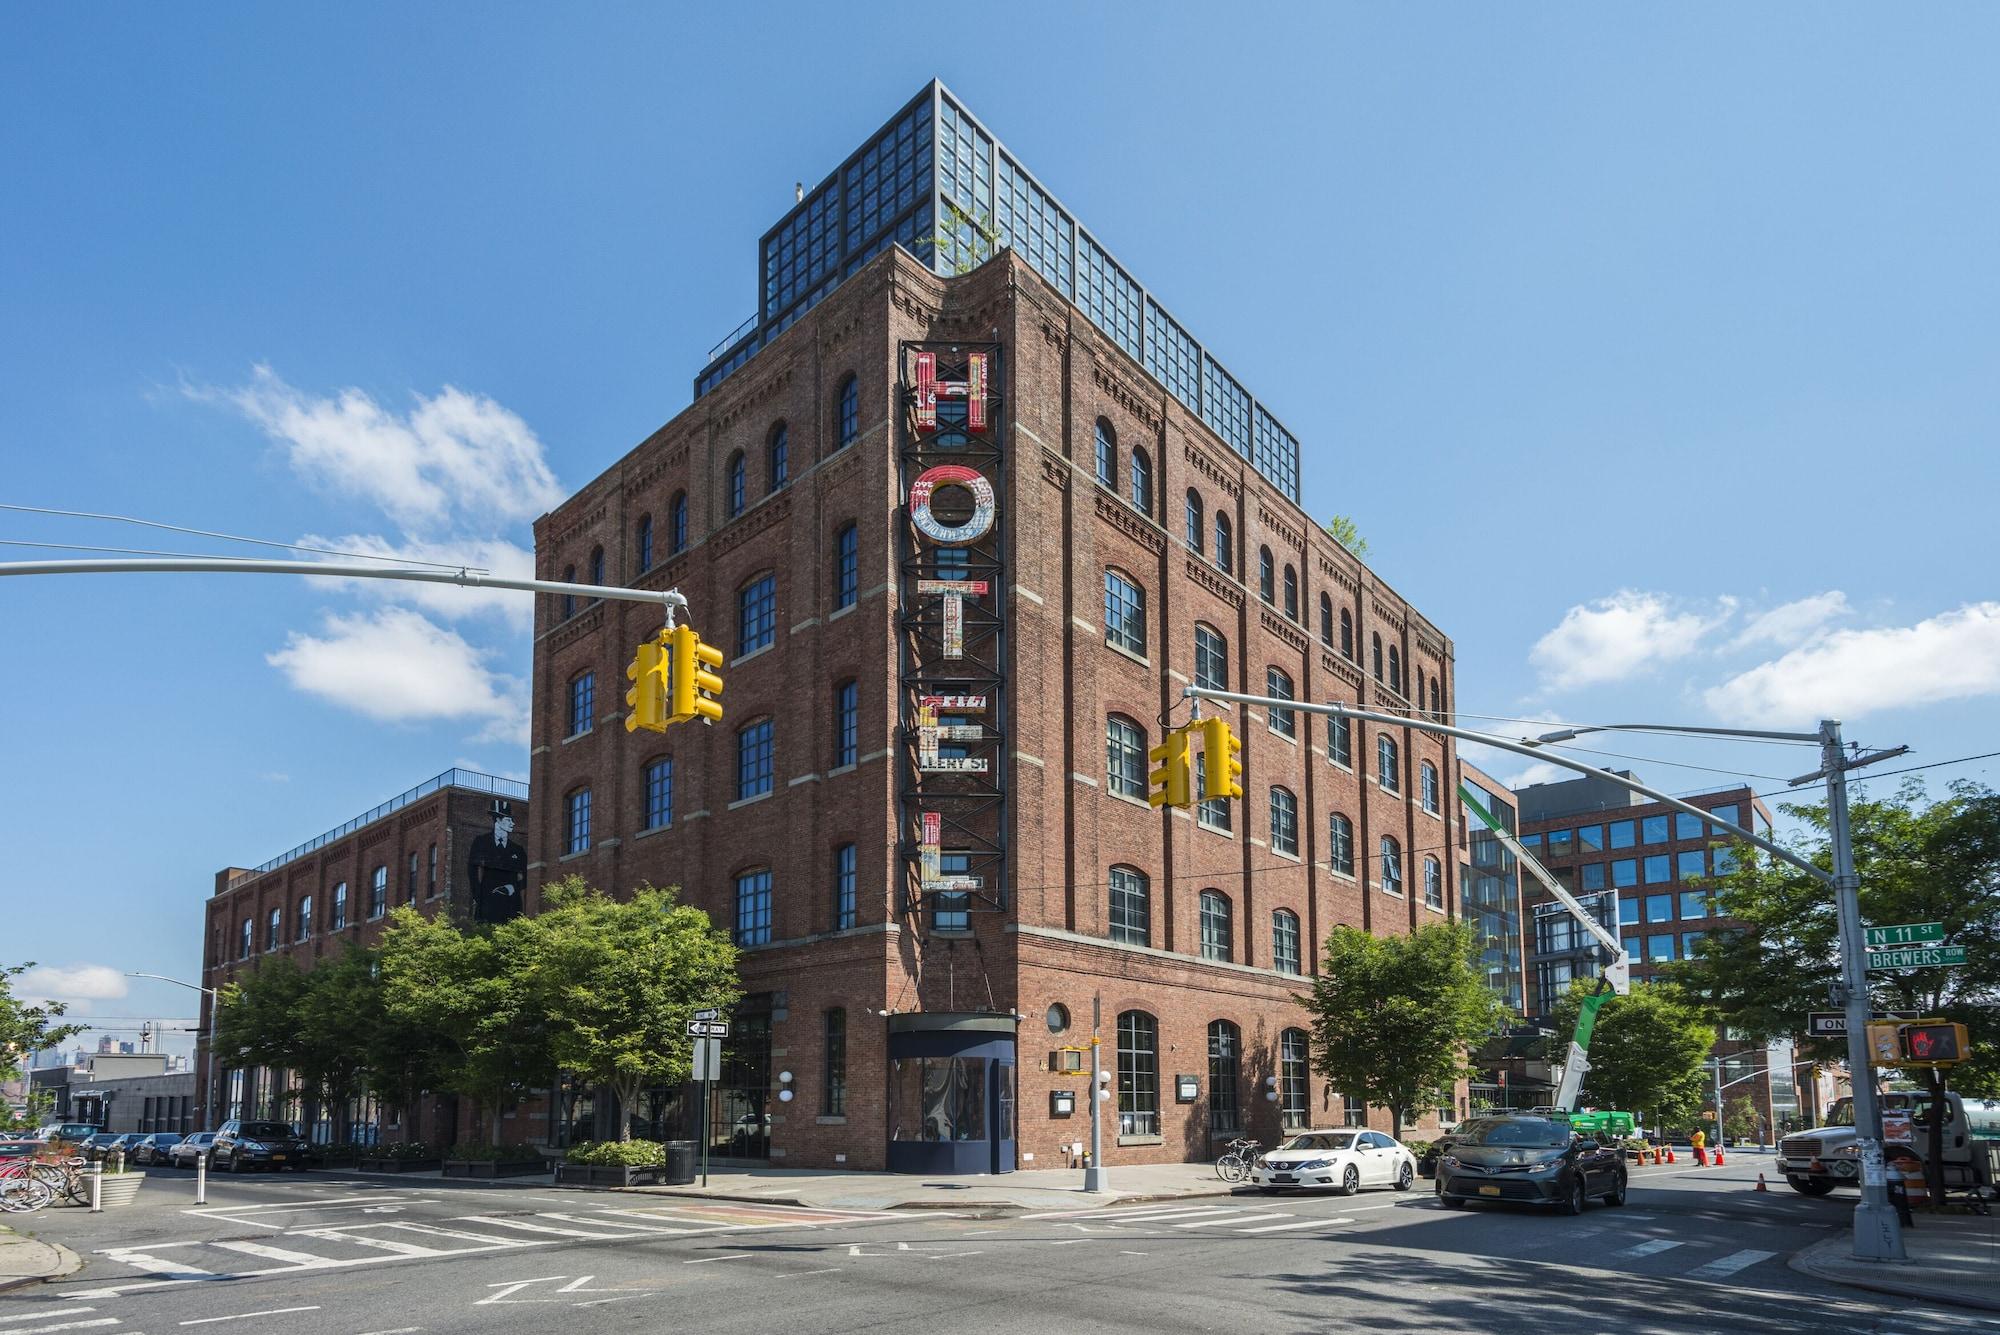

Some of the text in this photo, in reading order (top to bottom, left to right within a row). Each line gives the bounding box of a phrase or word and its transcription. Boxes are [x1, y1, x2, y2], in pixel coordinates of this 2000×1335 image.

[909, 352, 995, 892] HOTEL
[1874, 925, 1933, 943] N 11 St
[1872, 947, 1964, 967] BREWERS ROW
[1825, 1019, 1845, 1029] ON
